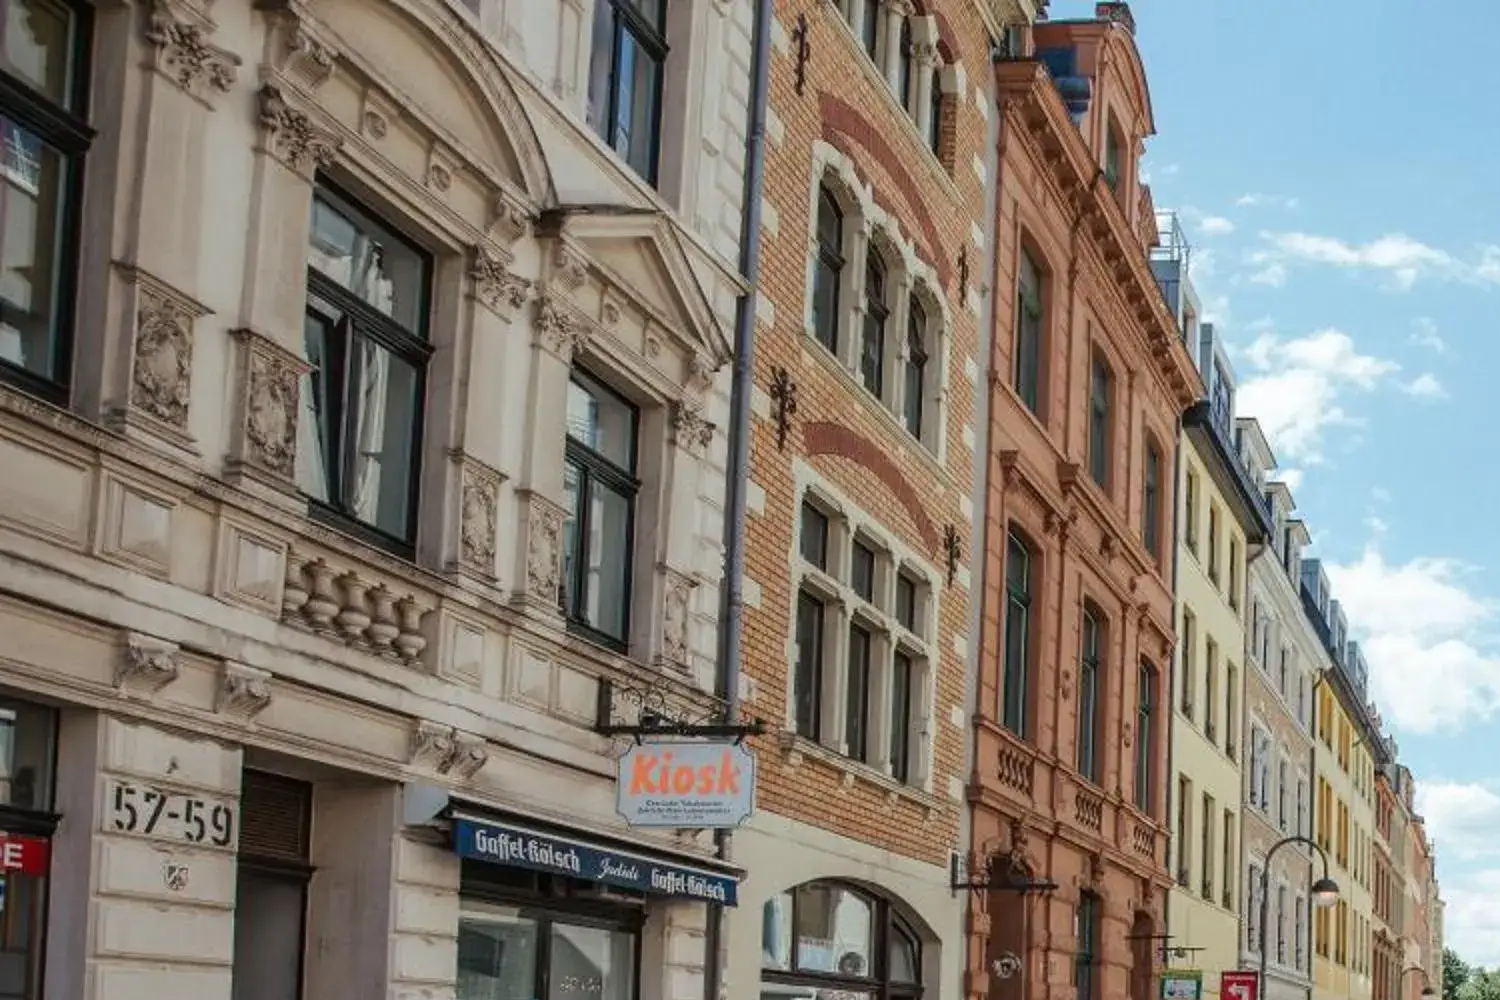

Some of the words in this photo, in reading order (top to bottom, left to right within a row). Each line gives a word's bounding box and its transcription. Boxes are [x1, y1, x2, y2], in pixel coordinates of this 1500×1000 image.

[629, 749, 741, 796] Kiosk
[115, 785, 232, 847] 57-59
[0, 842, 23, 869] E
